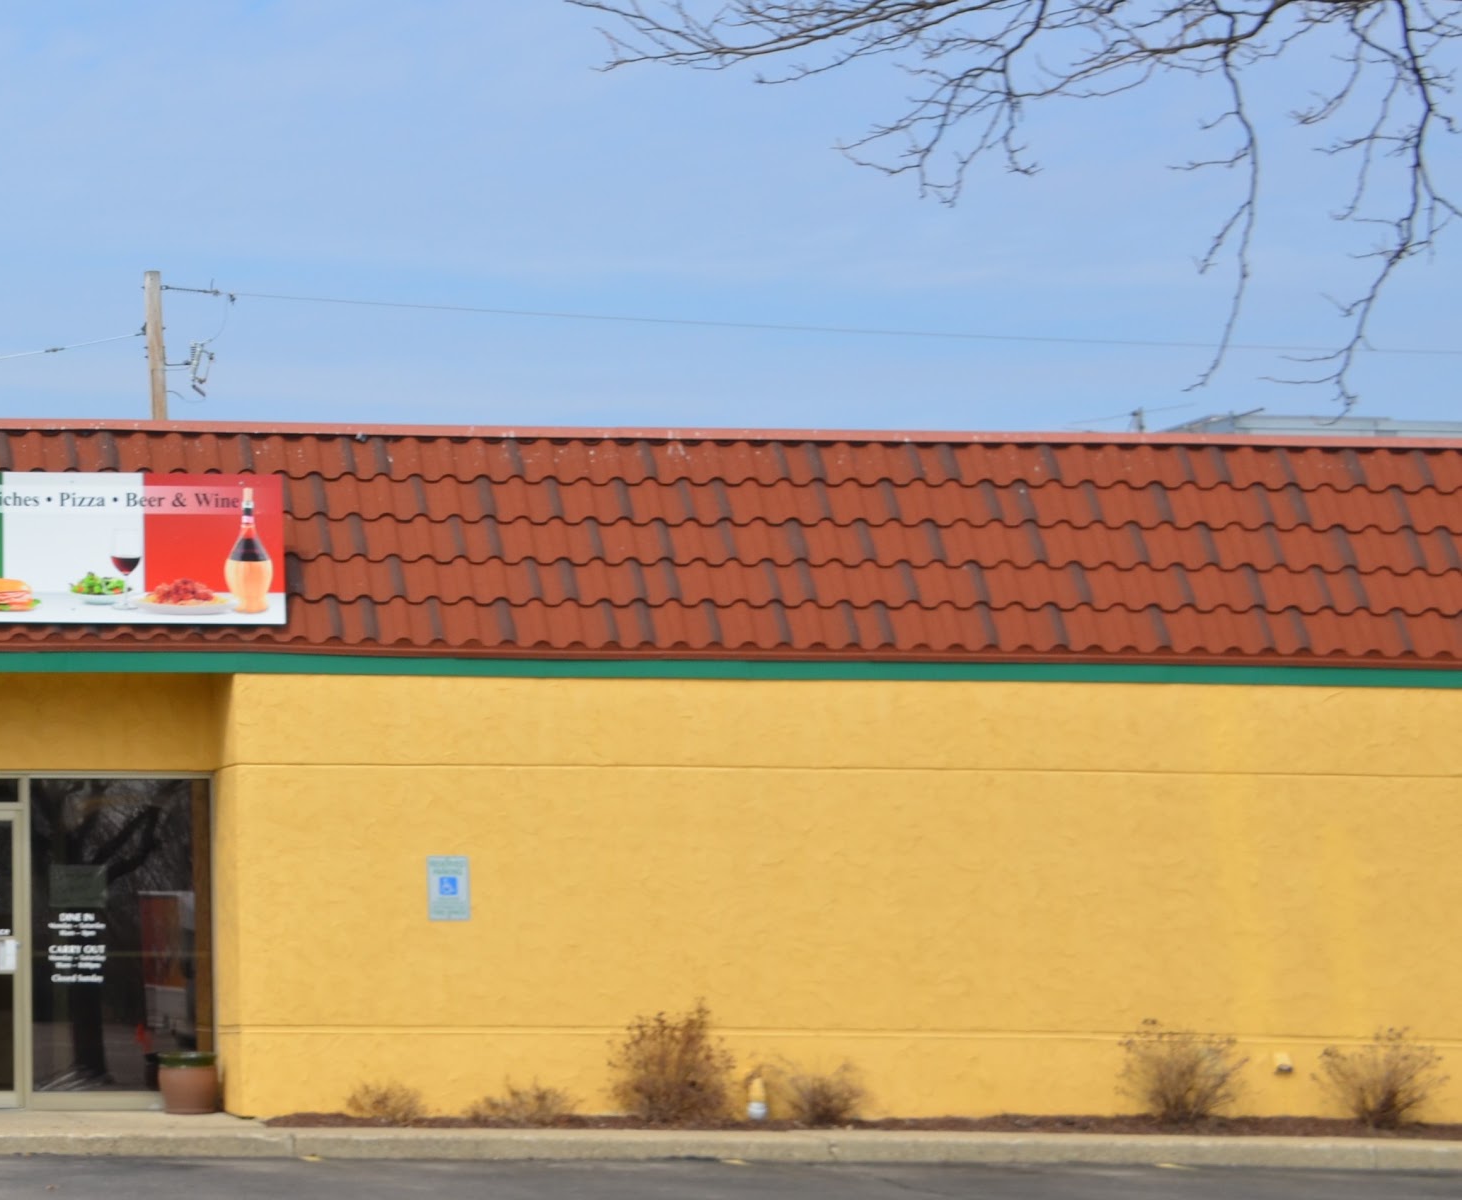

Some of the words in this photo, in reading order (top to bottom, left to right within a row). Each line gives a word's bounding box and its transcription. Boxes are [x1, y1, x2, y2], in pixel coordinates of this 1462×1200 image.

[59, 491, 106, 507] Pizza
[125, 492, 166, 508] Beer
[171, 492, 187, 508] &
[194, 492, 239, 509] Wine
